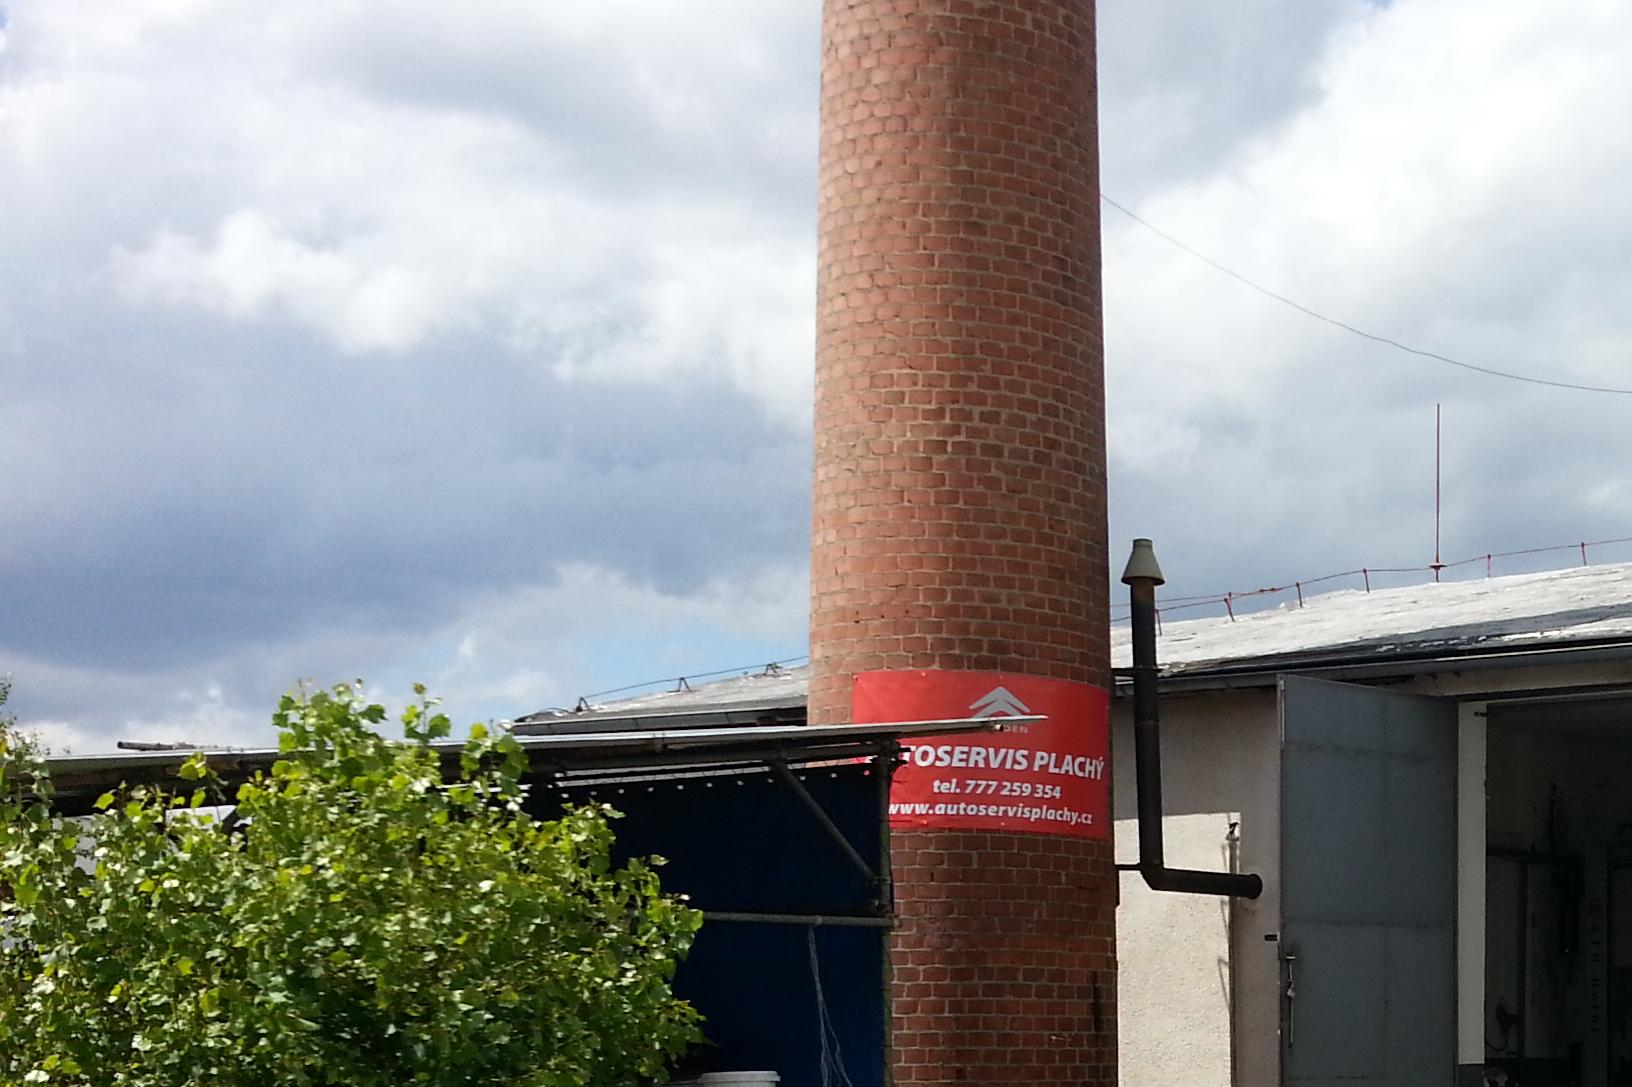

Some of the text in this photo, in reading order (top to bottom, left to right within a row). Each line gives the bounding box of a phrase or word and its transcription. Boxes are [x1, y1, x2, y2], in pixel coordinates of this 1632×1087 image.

[1033, 751, 1105, 780] PLACHÝ
[933, 778, 1062, 799] tel. 777 259 354
[888, 802, 1093, 826] www.autoservisplachy.cz
